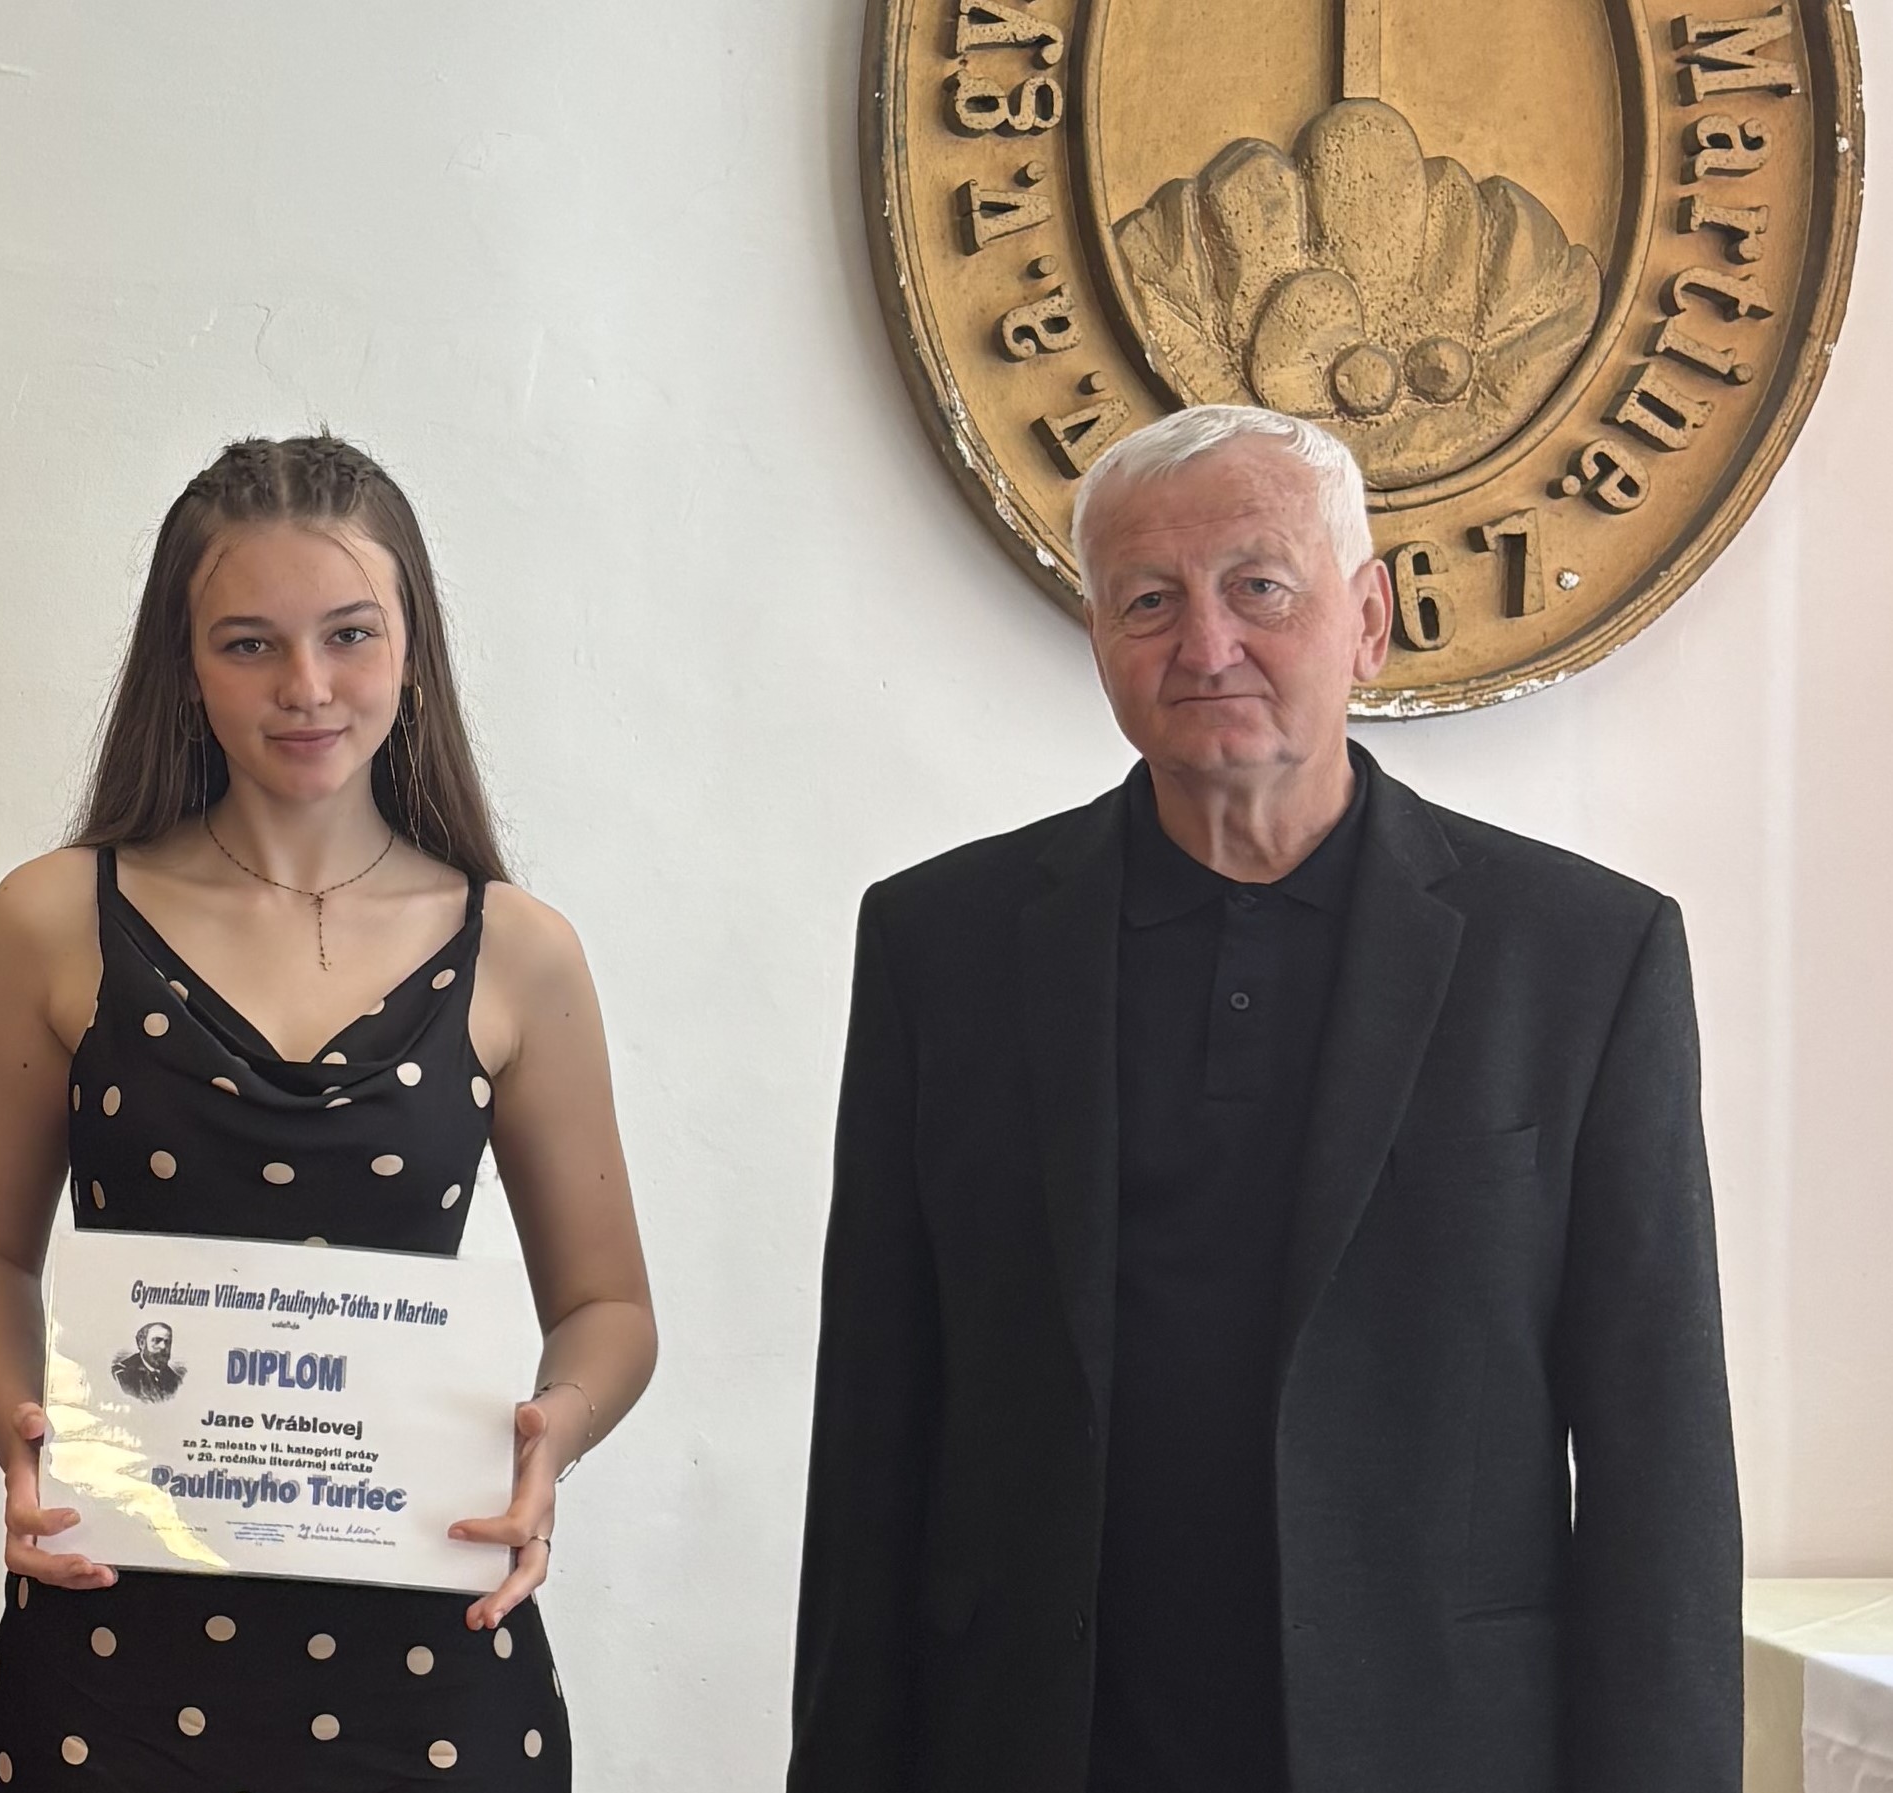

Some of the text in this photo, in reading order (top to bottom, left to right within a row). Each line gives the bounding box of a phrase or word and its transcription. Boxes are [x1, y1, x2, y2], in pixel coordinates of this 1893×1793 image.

[131, 1280, 448, 1326] Gymnázium Viliama Paulinyho-Tótha v Martine
[227, 1347, 347, 1392] DIPLOM
[201, 1410, 363, 1440] Jane Vráblovej
[187, 1453, 194, 1461] v
[200, 1438, 211, 1448] 2.
[260, 1444, 267, 1452] v
[151, 1465, 407, 1513] Paulinyho Turiec
